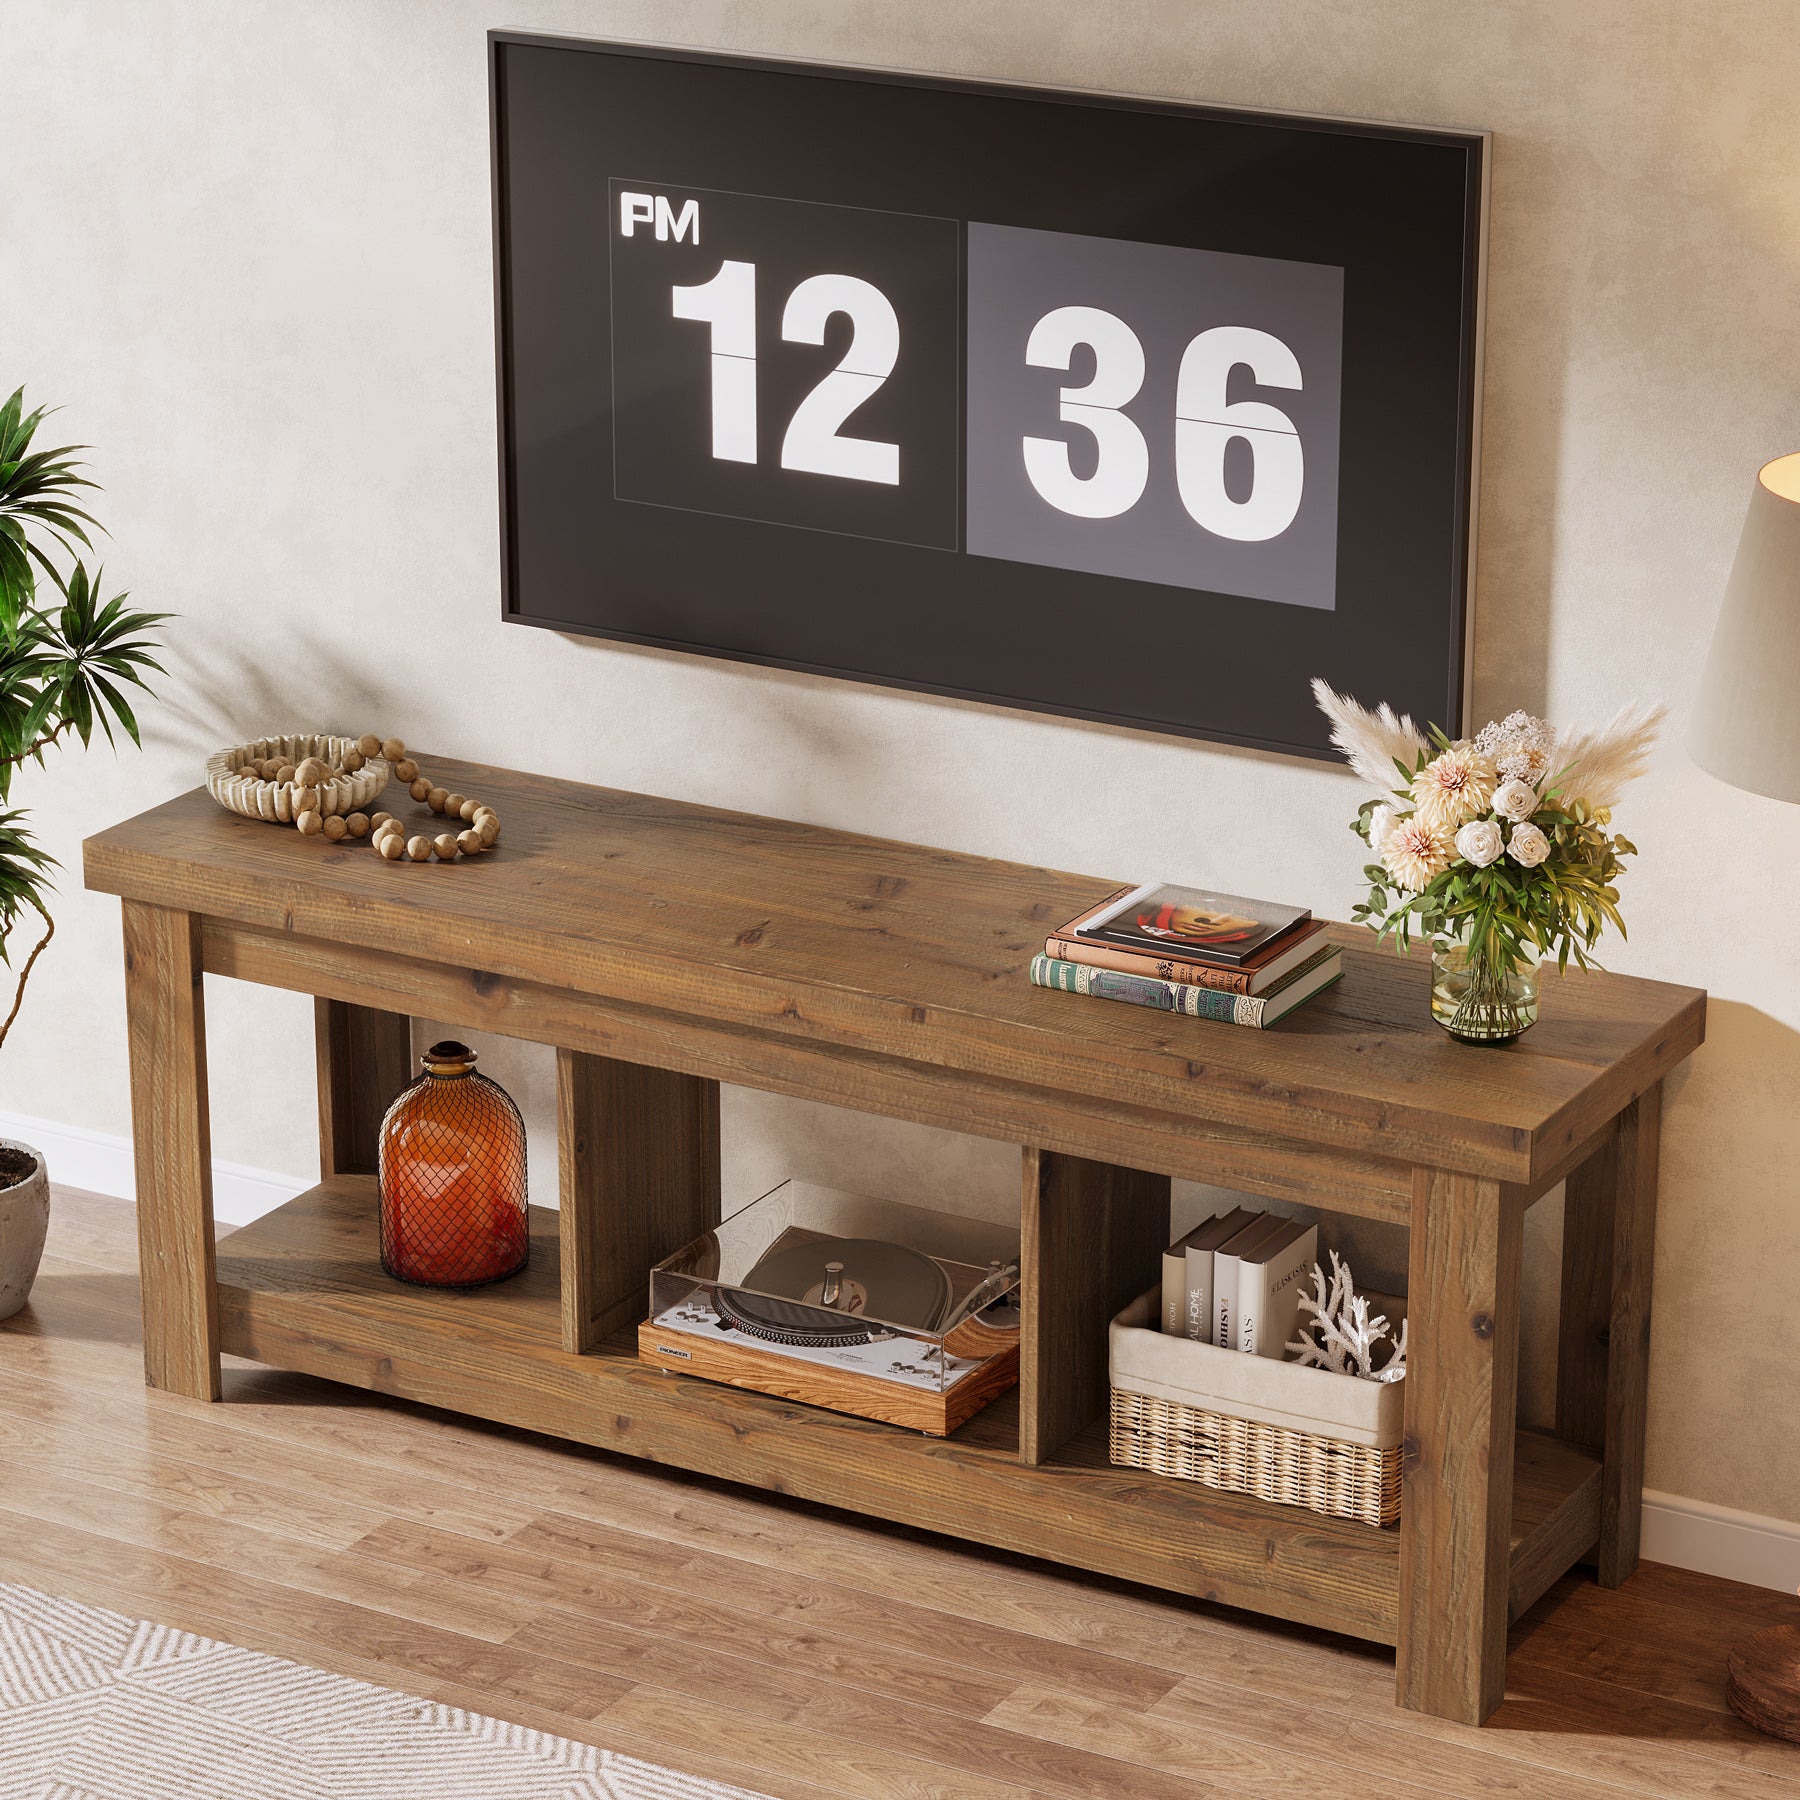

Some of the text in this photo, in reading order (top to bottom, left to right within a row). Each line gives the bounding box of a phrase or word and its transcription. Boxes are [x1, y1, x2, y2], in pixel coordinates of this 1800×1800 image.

[619, 190, 701, 246] PM
[671, 259, 1305, 542] 12 36
[1168, 1302, 1177, 1333] HOME
[1189, 1288, 1200, 1325] HOME
[1220, 1297, 1229, 1348] FASHIO
[659, 1346, 688, 1358] PIONEER
